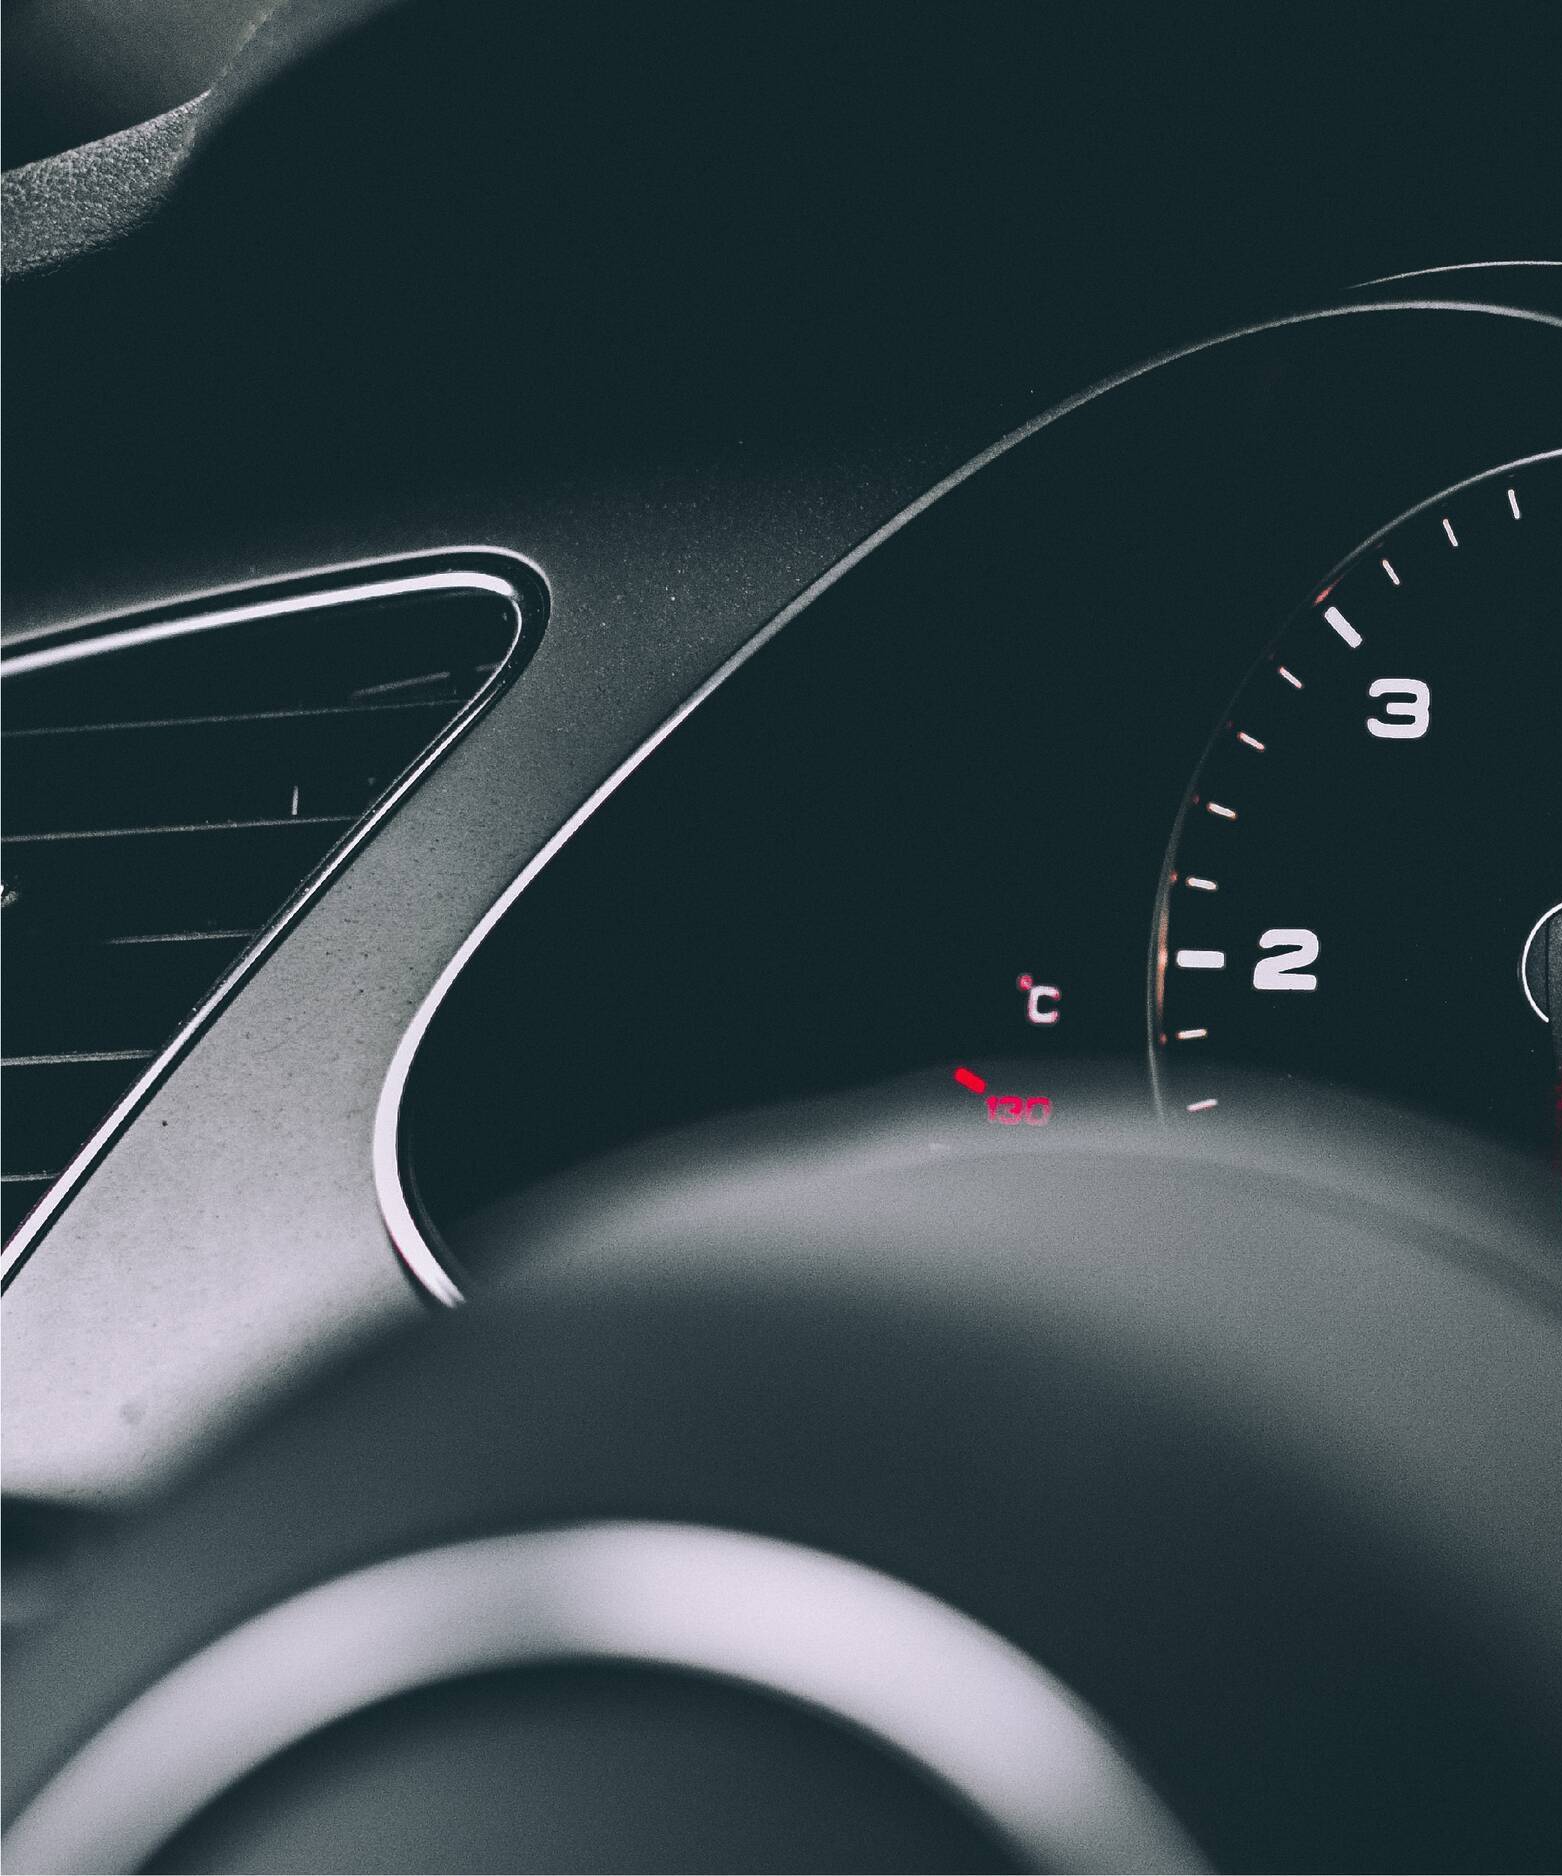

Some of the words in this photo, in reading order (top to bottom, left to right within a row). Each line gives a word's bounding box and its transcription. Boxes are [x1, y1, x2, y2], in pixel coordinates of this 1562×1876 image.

[1366, 678, 1431, 739] 3
[1252, 928, 1320, 991] 2
[985, 1095, 1051, 1126] 130
